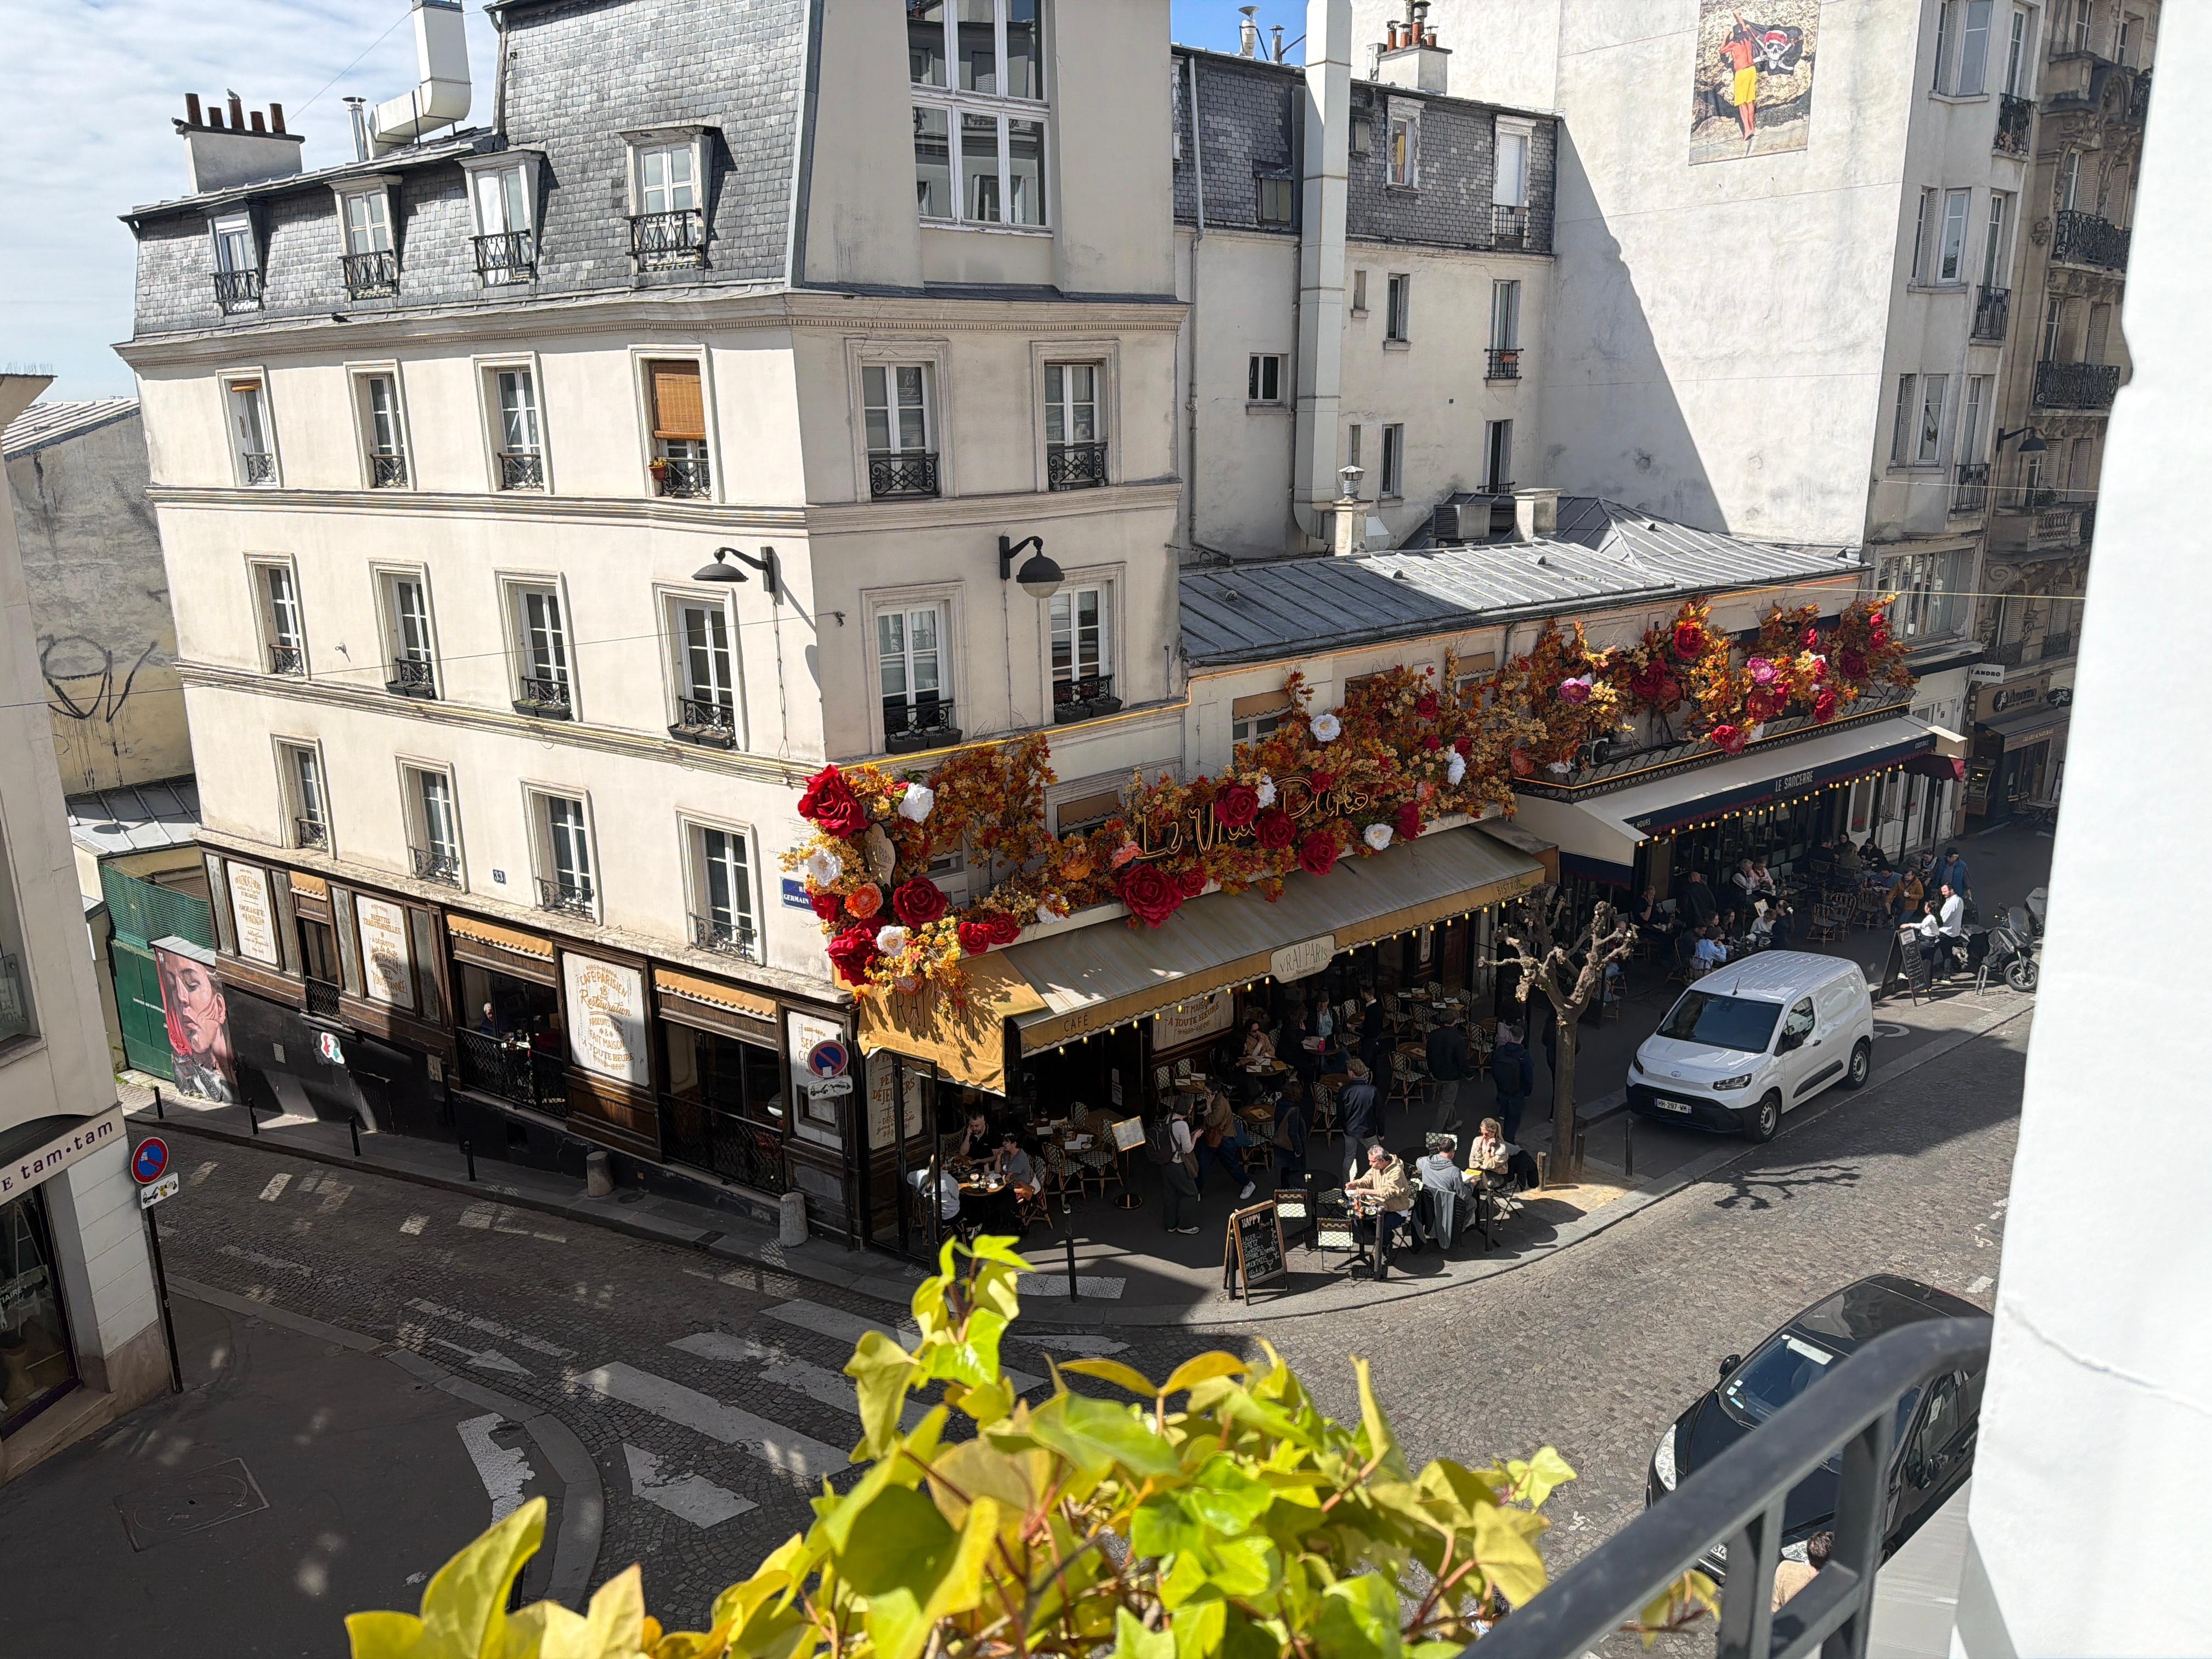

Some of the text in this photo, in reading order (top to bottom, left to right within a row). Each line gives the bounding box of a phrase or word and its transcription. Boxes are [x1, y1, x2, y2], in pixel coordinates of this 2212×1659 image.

[1775, 770, 1814, 793] LE SANCERRE
[494, 871, 504, 882] 33
[783, 894, 809, 905] GERMAIN
[363, 917, 402, 935] TRADITIONNELLES
[370, 913, 391, 924] RECETTES
[370, 952, 403, 975] MONTMARTRE
[1280, 943, 1328, 973] VRAI PARIS
[597, 972, 628, 998] PARISIEN
[579, 989, 633, 1017] Restauration
[589, 1017, 611, 1028] PRODUITS
[1064, 1012, 1088, 1032] CAFÉ
[1175, 1016, 1198, 1027] TOUTE
[1198, 1001, 1220, 1022] HEURE
[589, 1029, 625, 1050] FAIT MAISON
[589, 1043, 612, 1060] TOUTE
[612, 1052, 634, 1063] HEURE
[1242, 1212, 1261, 1228] HAPPY
